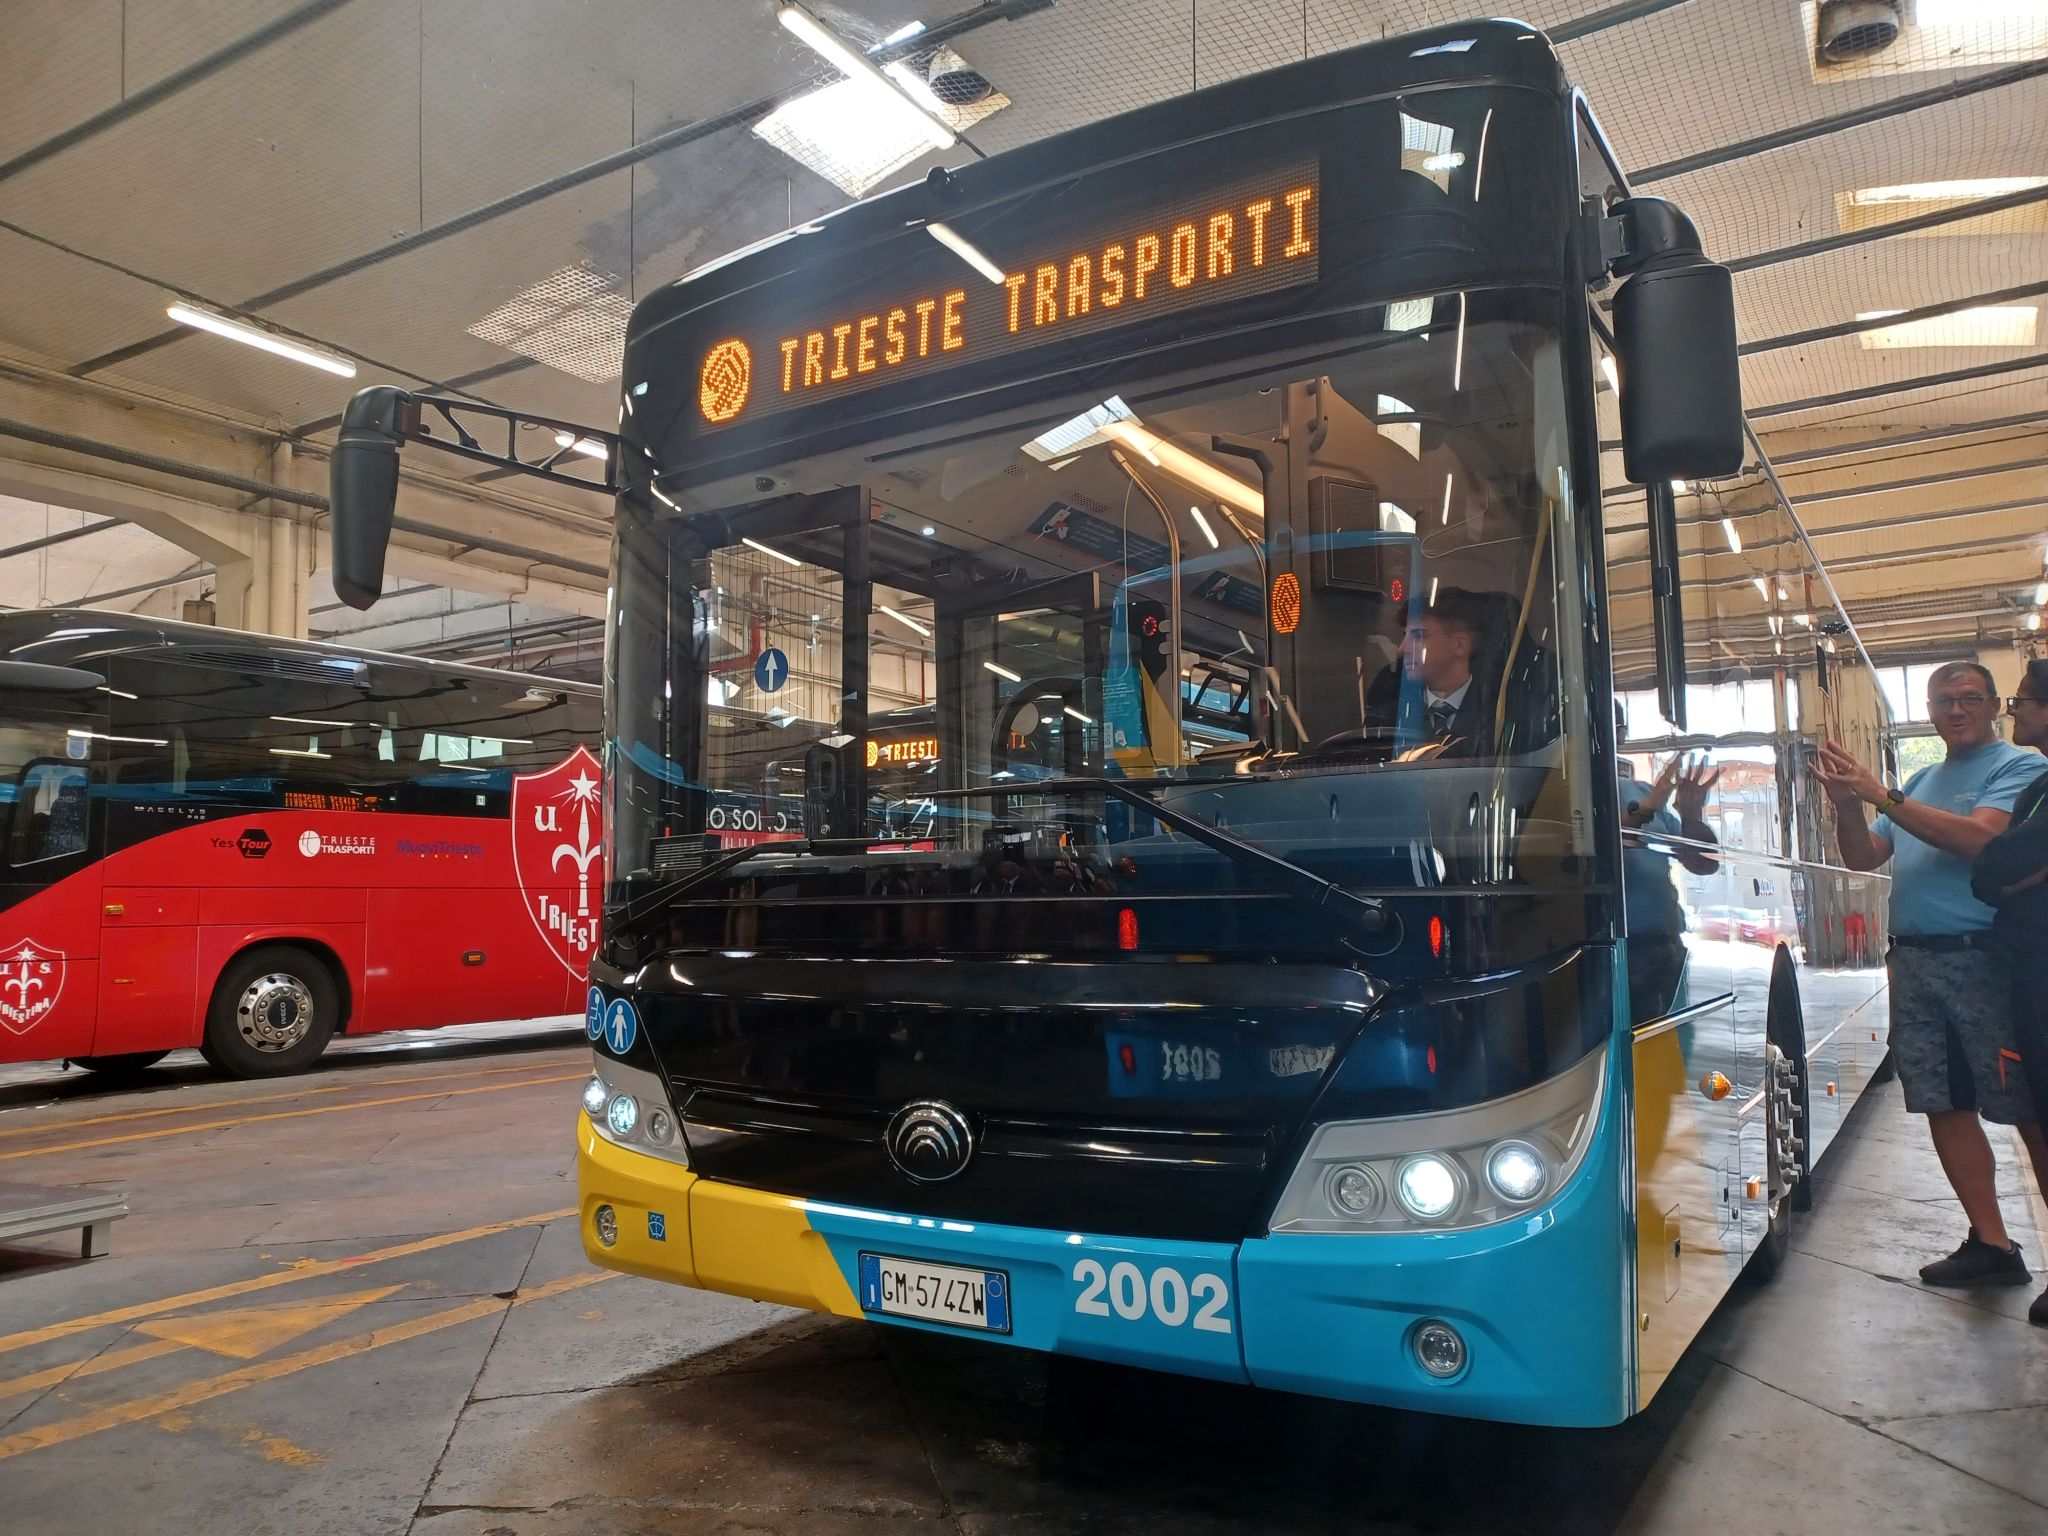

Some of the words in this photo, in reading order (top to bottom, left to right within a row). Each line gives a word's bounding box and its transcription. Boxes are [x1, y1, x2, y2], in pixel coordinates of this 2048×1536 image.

[780, 290, 966, 392] TRIESTE
[1004, 188, 1313, 332] TRASPORTI
[887, 740, 938, 761] TRIEST
[210, 837, 235, 848] Yes
[240, 839, 269, 849] Tour
[321, 836, 376, 846] TRIESTE
[321, 845, 375, 855] TRASPORTI
[1072, 1258, 1232, 1334] 2002
